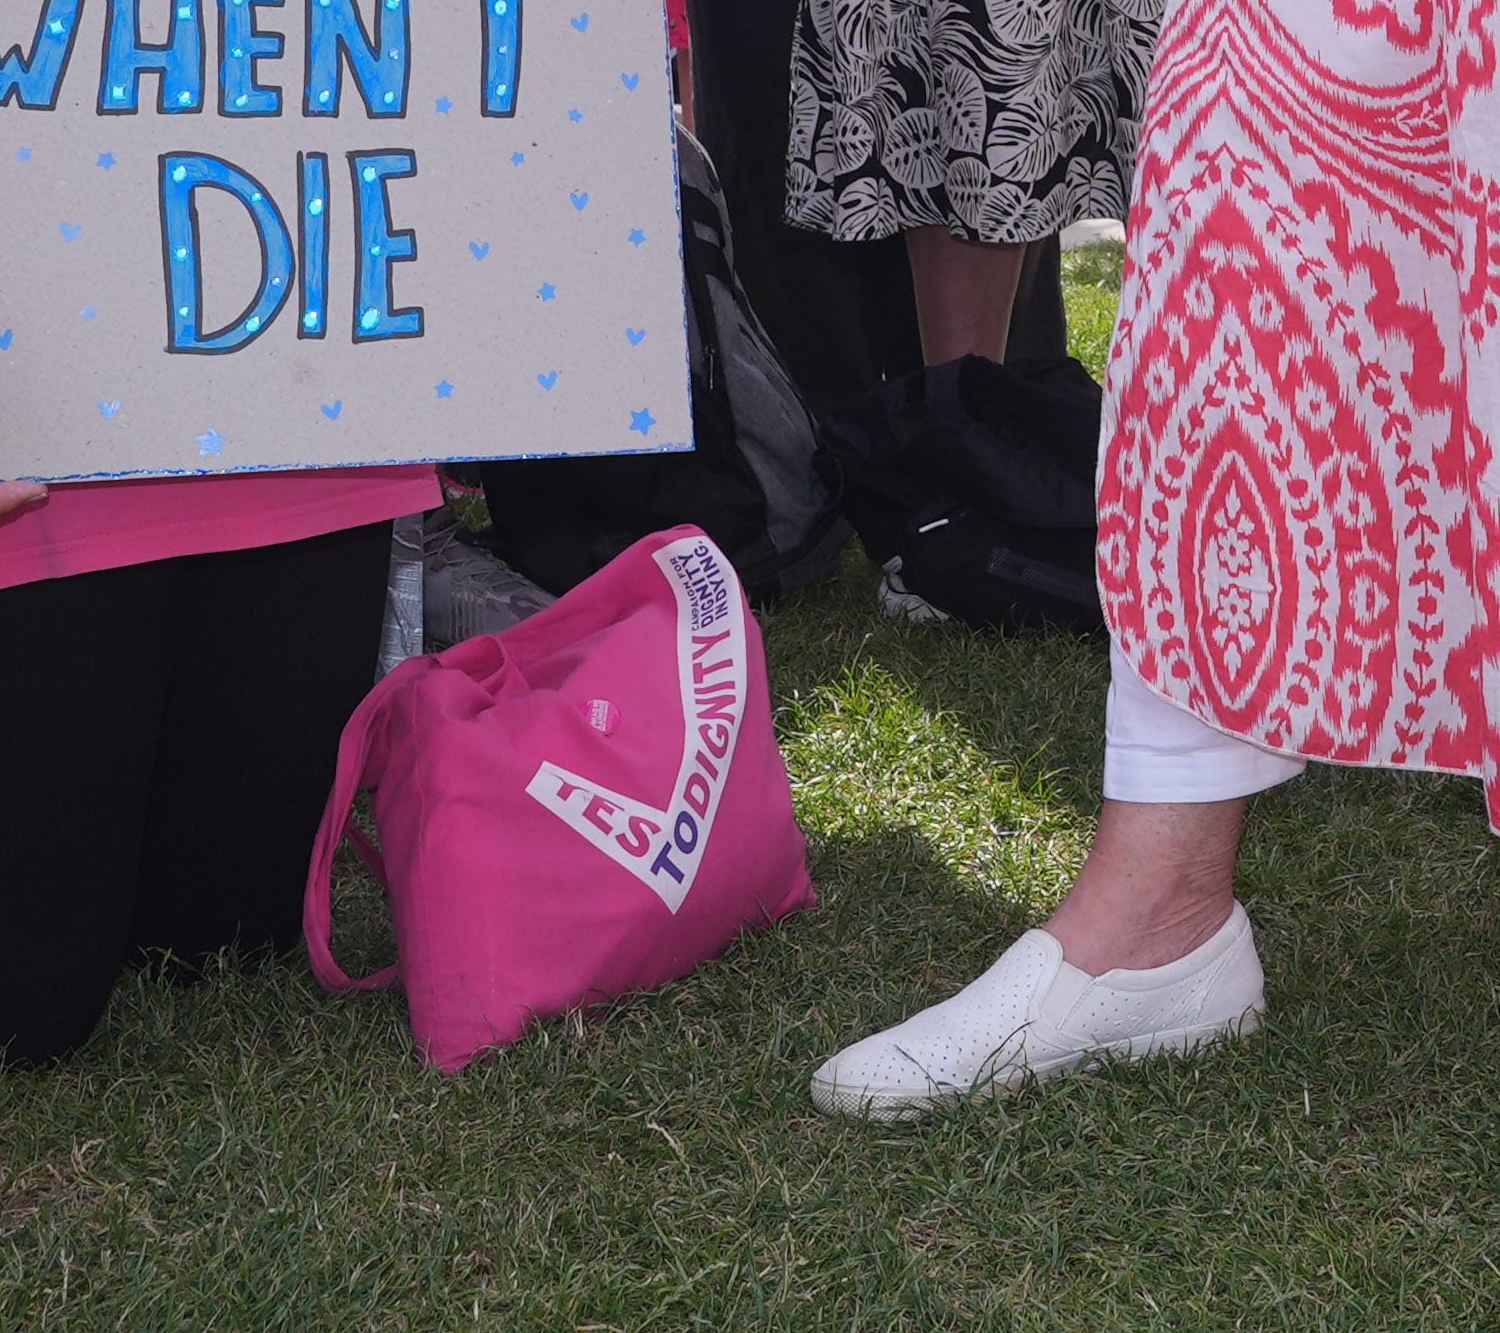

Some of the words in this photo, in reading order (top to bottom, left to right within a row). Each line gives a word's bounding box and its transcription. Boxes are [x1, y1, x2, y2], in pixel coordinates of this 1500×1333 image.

[158, 149, 425, 354] DIE
[669, 556, 686, 579] FOR
[677, 553, 716, 629] DIGNITY
[684, 581, 700, 631] CAMPAIGN
[650, 810, 699, 885] TO
[683, 629, 736, 820] DIGNITY
